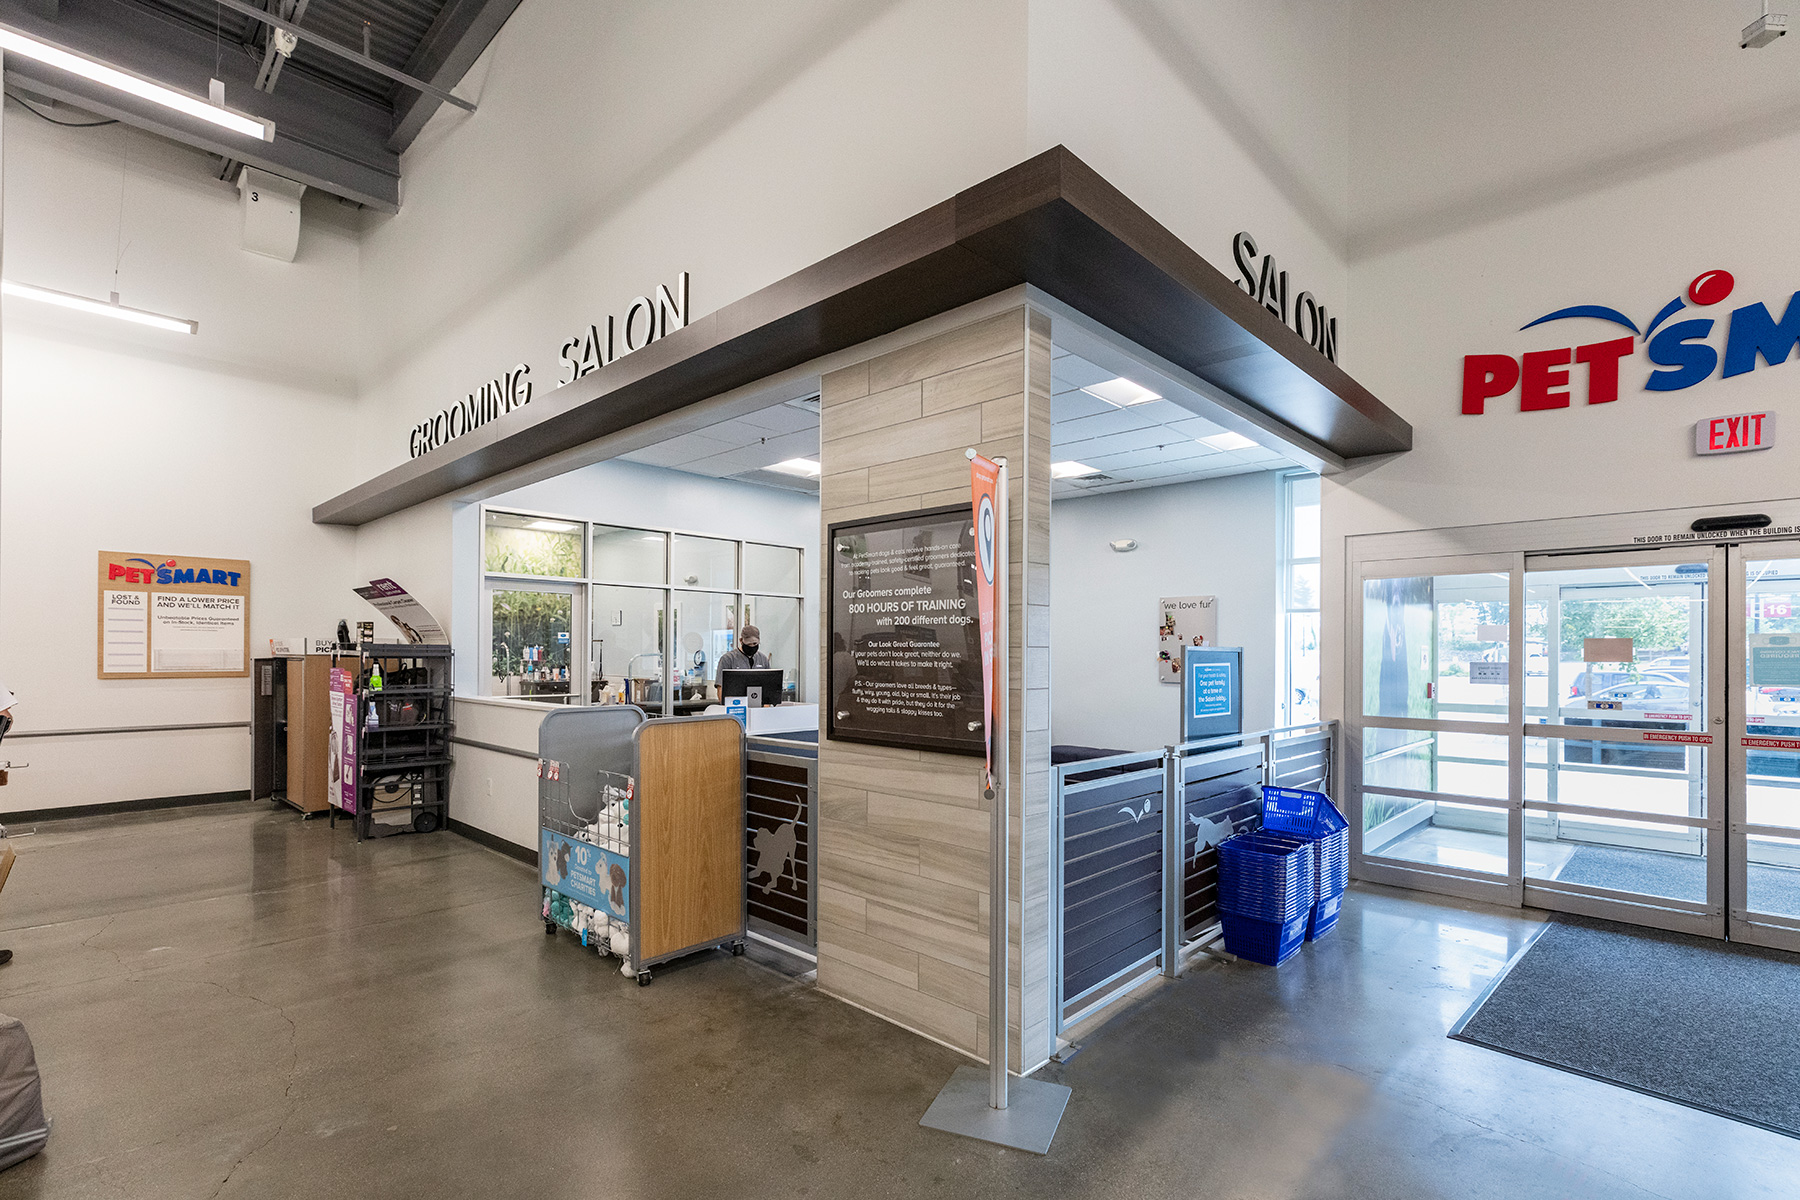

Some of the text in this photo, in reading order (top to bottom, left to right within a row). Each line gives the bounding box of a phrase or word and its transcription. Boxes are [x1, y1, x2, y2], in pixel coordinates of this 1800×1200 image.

[251, 191, 259, 202] 3
[1233, 231, 1339, 369] SALON
[409, 271, 690, 459] GROOMING SALON
[1708, 413, 1767, 450] EXIT
[1647, 535, 1663, 543] DOOR
[1672, 532, 1696, 541] REMAIN
[1696, 530, 1728, 540] UNLOCKED
[1729, 529, 1748, 537] WHEN
[1749, 528, 1763, 536] THE
[1763, 525, 1793, 535] BUILDING
[1794, 525, 1800, 533] IS
[108, 561, 241, 587] PETSMART
[842, 586, 932, 599] Our Groomers complete
[849, 598, 967, 614] 800 HOURS OF TRAINING
[1179, 601, 1197, 609] love
[1199, 600, 1211, 608] fur
[876, 614, 974, 626] with 200 different dogs.
[868, 640, 941, 648] Our Look Great Guarantee
[921, 650, 941, 658] neither
[942, 650, 950, 658] do
[857, 659, 869, 667] We'll
[895, 660, 910, 668] takes
[865, 680, 874, 688] Our
[901, 691, 909, 699] big
[951, 693, 961, 701] job
[1748, 739, 1780, 747] EMERGENCY
[571, 869, 596, 887] PETSMART
[571, 879, 596, 897] CHARITIES
